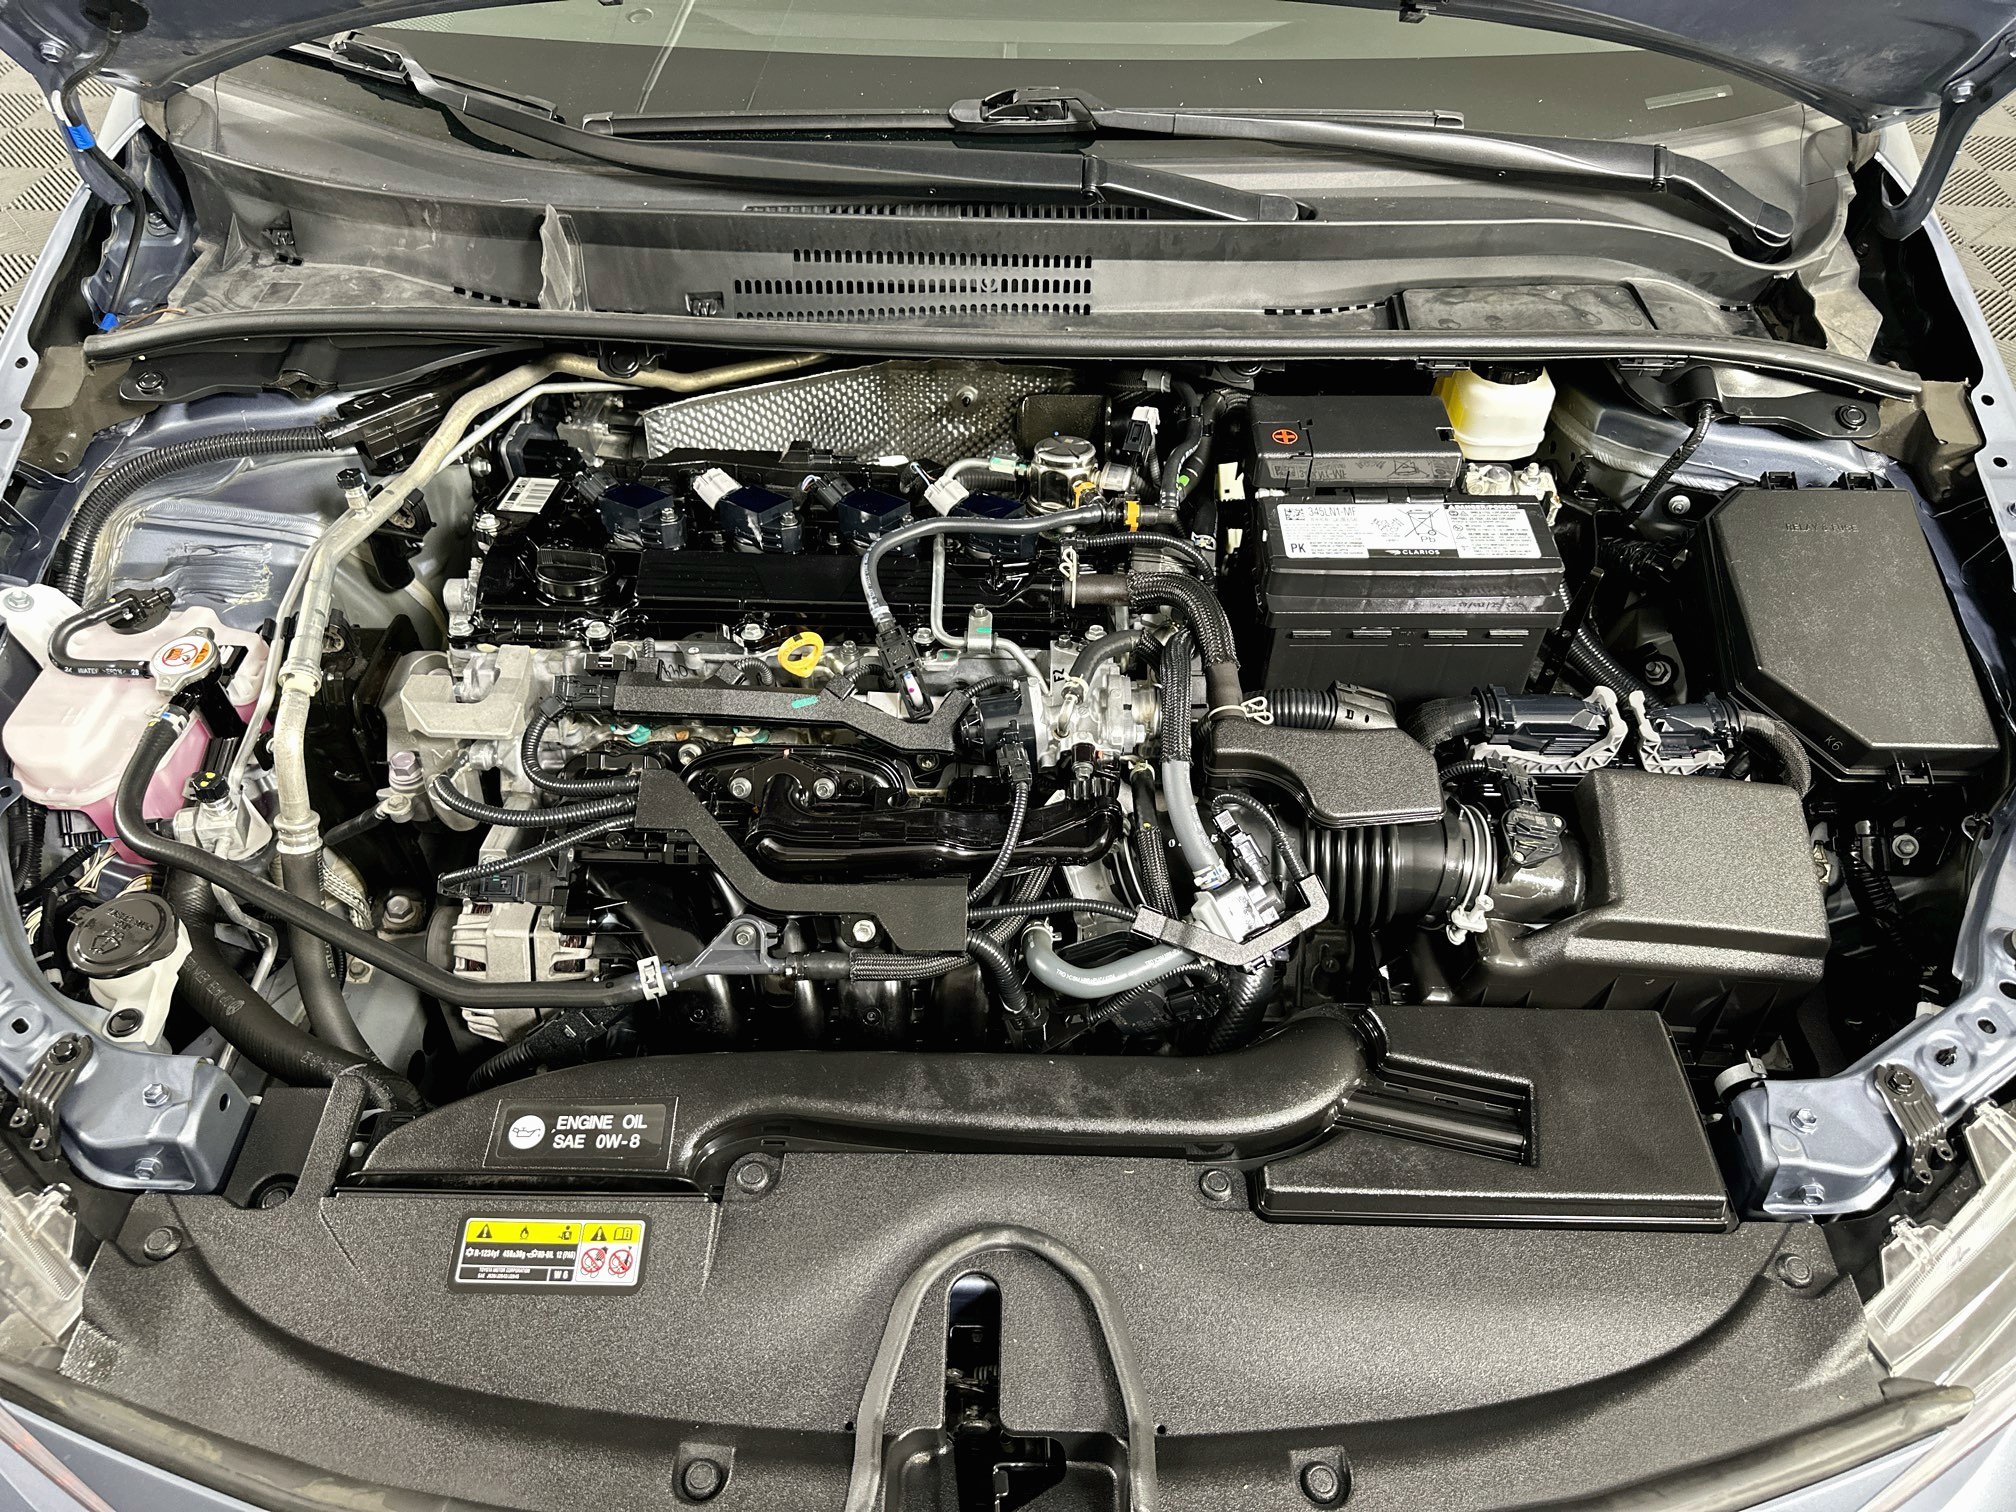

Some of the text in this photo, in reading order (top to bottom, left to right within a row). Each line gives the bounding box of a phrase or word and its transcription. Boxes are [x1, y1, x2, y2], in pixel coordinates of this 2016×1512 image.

[1785, 523, 1818, 532] RELAY
[1831, 523, 1858, 533] FUSE
[1290, 543, 1306, 553] PK
[1401, 548, 1441, 556] CLARIOS
[1824, 735, 1843, 751] K6
[556, 1114, 648, 1130] ENGINE OIL
[553, 1134, 641, 1149] SAE 0W-8
